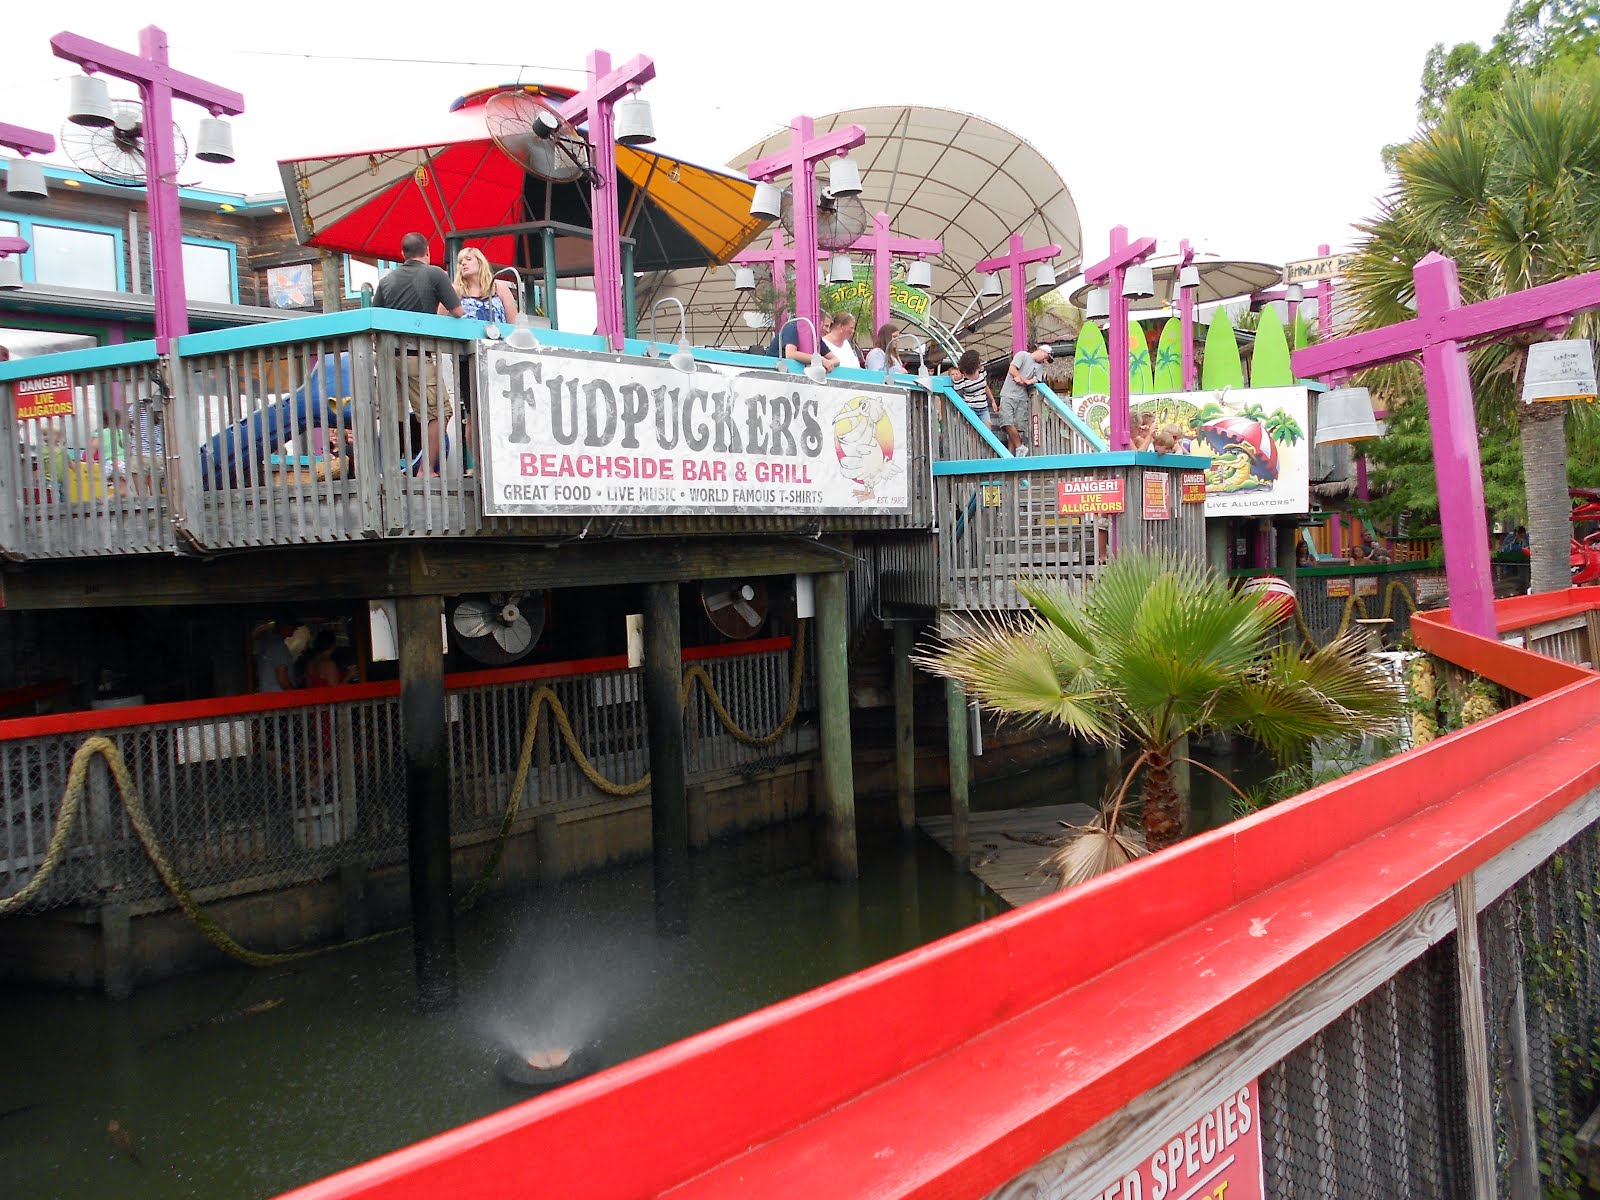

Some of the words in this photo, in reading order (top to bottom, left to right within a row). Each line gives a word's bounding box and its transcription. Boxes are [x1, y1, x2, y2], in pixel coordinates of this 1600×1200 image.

[20, 376, 68, 392] DANGER!
[35, 393, 54, 405] LIVE
[18, 402, 73, 418] ALLIGATORS
[495, 358, 824, 458] FUDPUCKER'S
[520, 453, 674, 480] BEACHSIDE
[682, 459, 727, 482] BAR
[734, 461, 748, 482] &
[755, 462, 812, 484] GRILL
[503, 484, 549, 501] GREAT
[554, 485, 592, 501] FOOD
[607, 486, 635, 502] LIVE
[639, 486, 677, 502] MUSIC
[689, 487, 729, 503] WORLD
[733, 488, 776, 504] FAMOUS
[779, 489, 823, 504] T-SHIRTS
[1064, 481, 1118, 492] DANGER!
[1081, 494, 1102, 503] LIVE
[1061, 502, 1122, 513] ALLIGATORS
[1151, 1085, 1251, 1200] SPECIES
